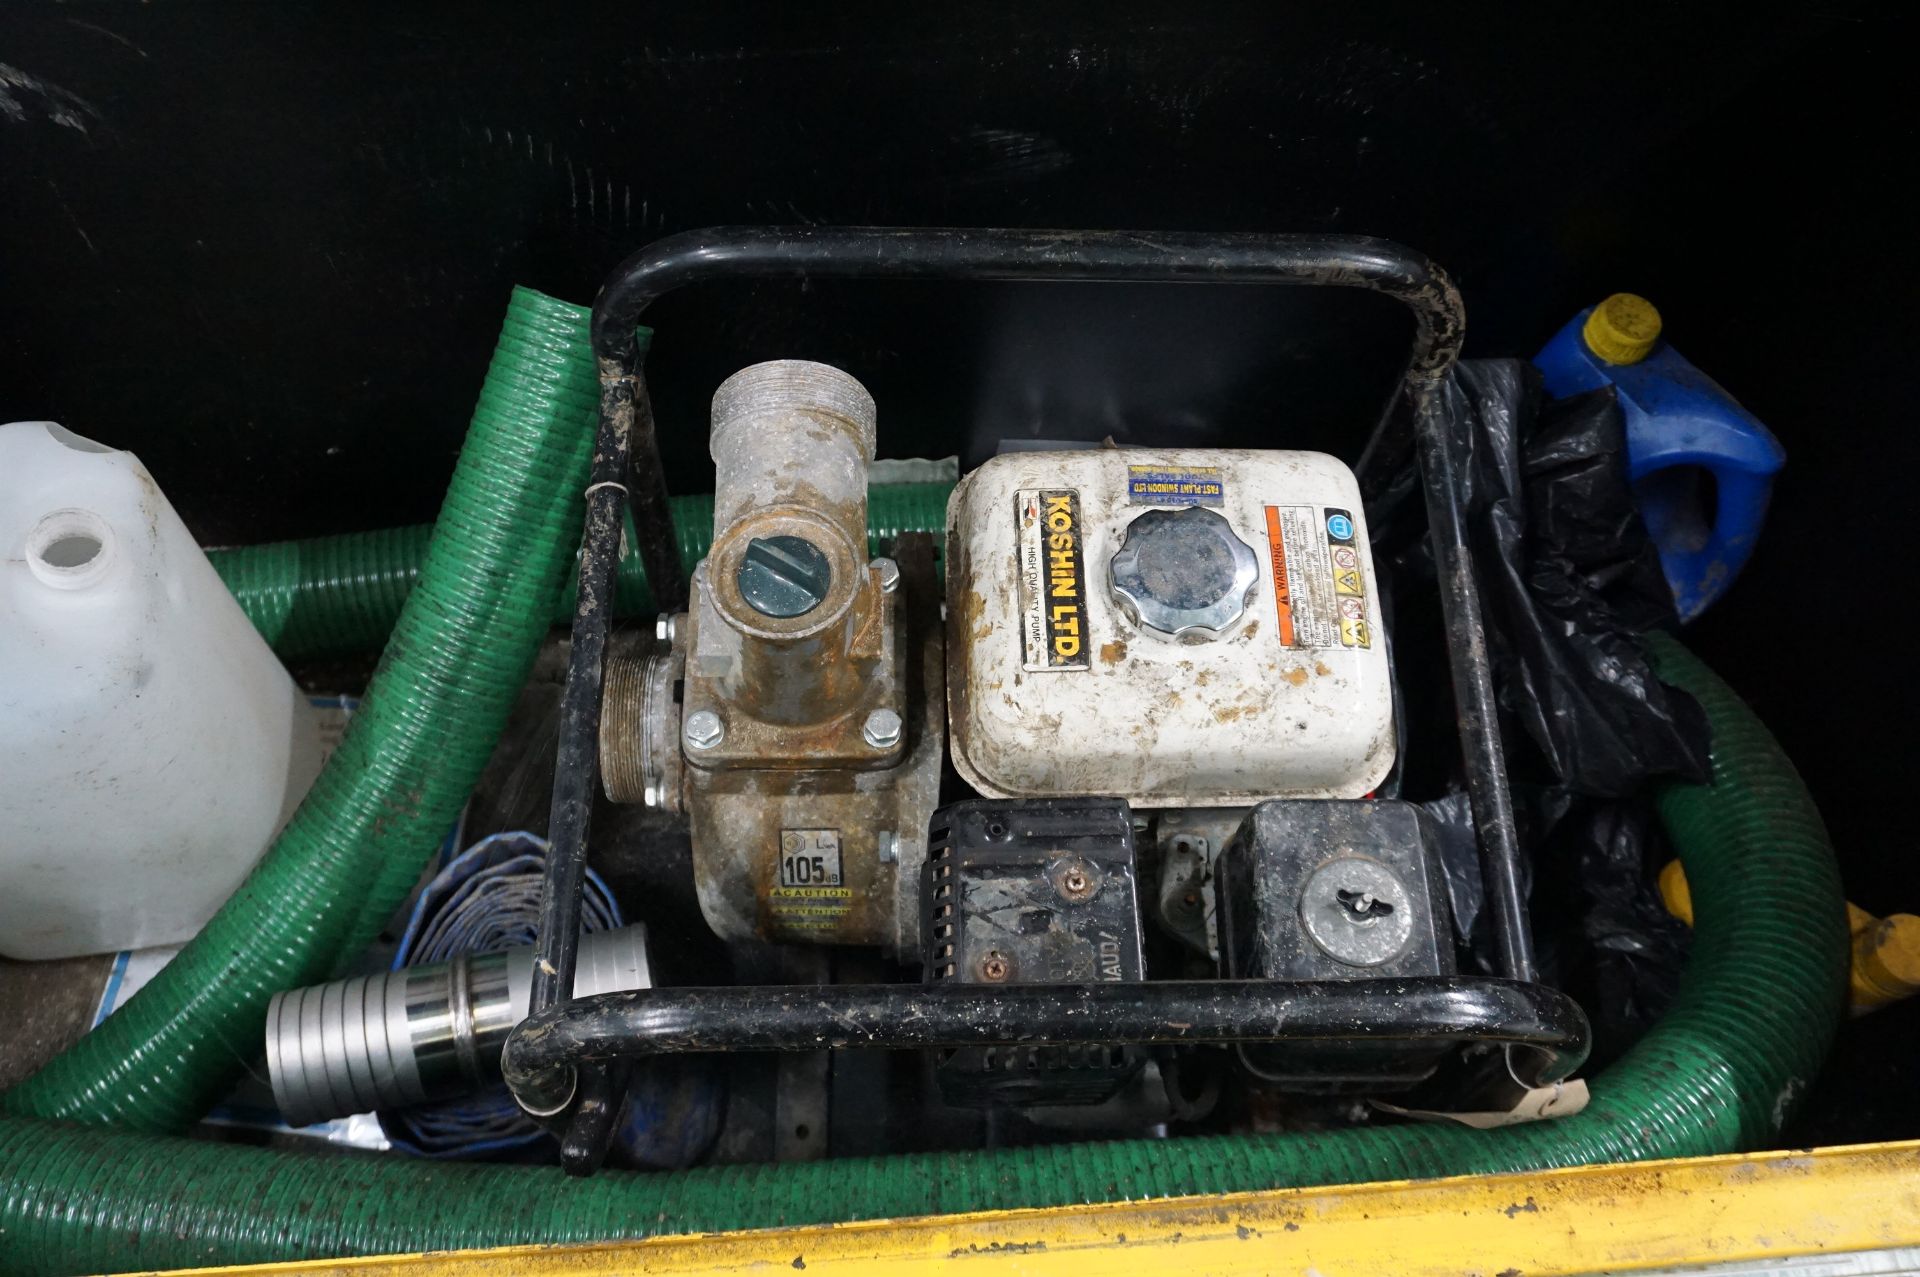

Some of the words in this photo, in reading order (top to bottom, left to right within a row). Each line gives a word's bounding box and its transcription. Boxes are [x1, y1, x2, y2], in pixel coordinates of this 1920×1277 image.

[1134, 482, 1146, 493] LTD
[1148, 483, 1178, 494] SWINDON
[1047, 496, 1077, 597] KOSHIN
[1027, 547, 1036, 570] HIGH
[1272, 543, 1286, 591] WARNING
[1301, 606, 1310, 628] engine
[1031, 617, 1041, 642] PUMP
[1302, 630, 1311, 644] Turn
[785, 856, 825, 884] 105
[783, 889, 849, 897] CAUTION
